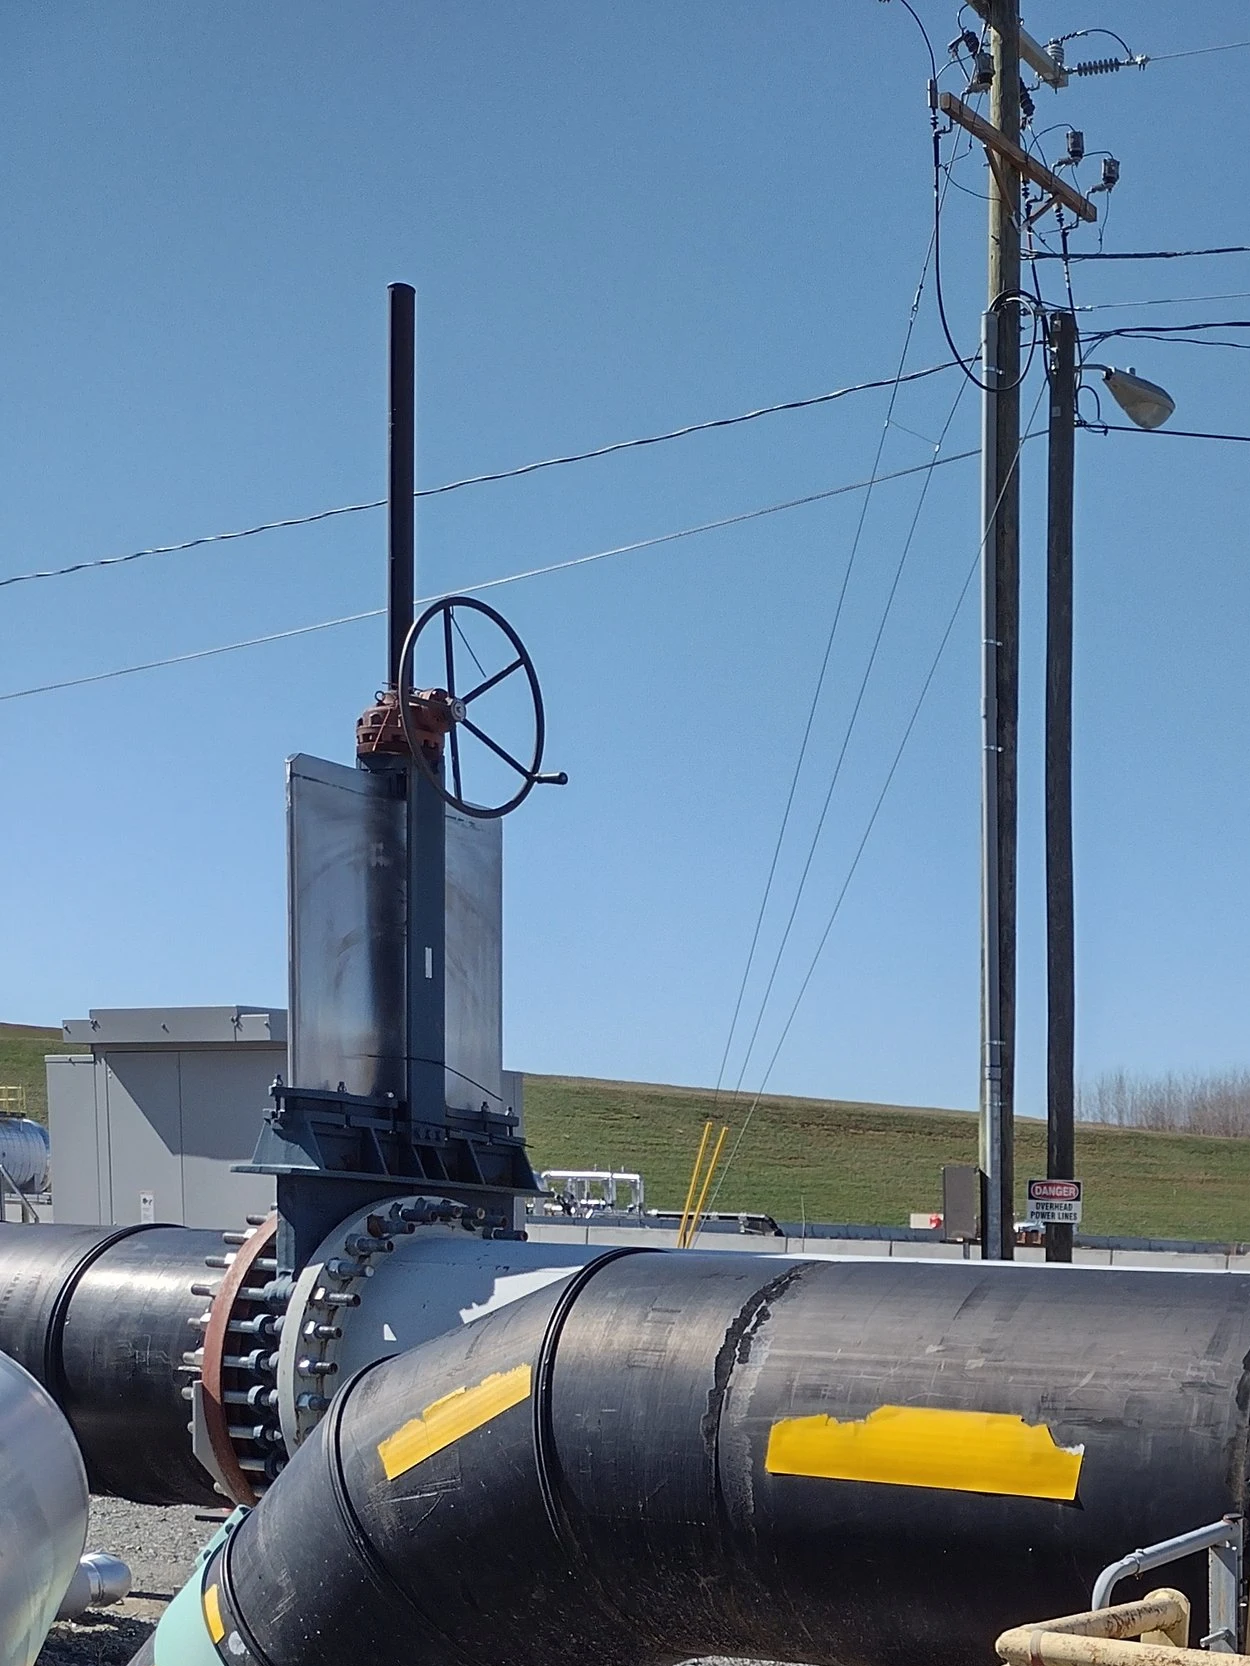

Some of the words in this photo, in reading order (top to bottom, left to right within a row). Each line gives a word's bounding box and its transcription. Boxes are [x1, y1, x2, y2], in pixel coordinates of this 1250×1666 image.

[1034, 1186, 1076, 1197] DANGER
[1035, 1202, 1073, 1211] OVERHEAD
[1030, 1211, 1056, 1220] POWER
[1057, 1212, 1078, 1221] LINES
